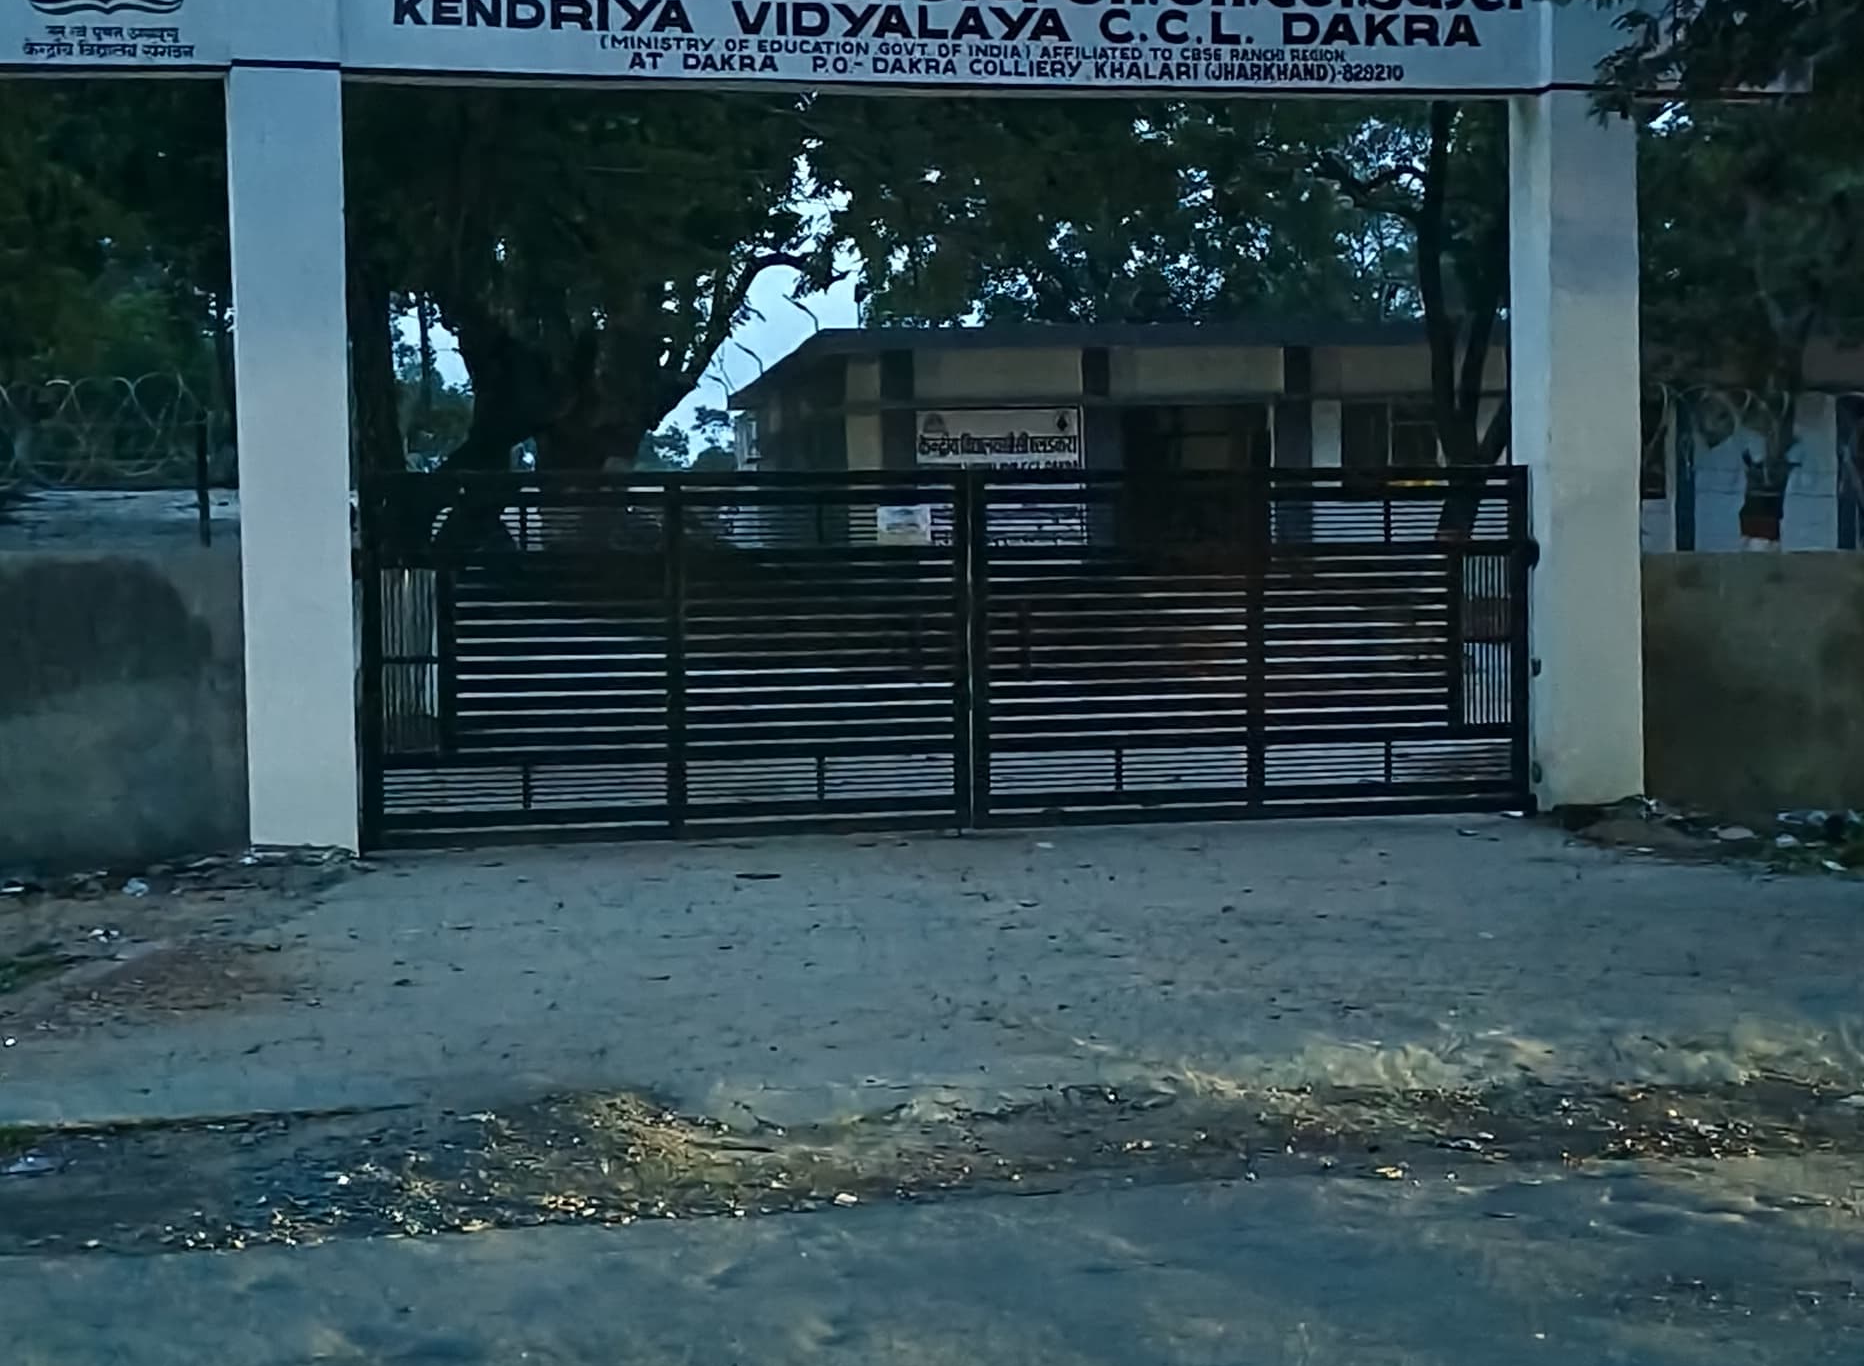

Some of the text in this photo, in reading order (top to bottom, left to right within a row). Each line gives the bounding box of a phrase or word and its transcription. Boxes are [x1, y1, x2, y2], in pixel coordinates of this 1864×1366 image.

[732, 0, 1072, 42] VIDYALAYA
[1282, 12, 1481, 47] DAKRA
[600, 34, 714, 52] (MINISTRY
[725, 38, 751, 52] OF
[757, 39, 869, 56] EDUCATION
[938, 43, 962, 57] OF
[968, 44, 1031, 60] INDIA)
[1040, 46, 1143, 61] AFFILIATED
[1149, 47, 1173, 62] TO
[1180, 48, 1222, 62] CBSE
[1230, 48, 1285, 62] RANCHI
[1290, 49, 1346, 63] REGION
[629, 52, 664, 70] AT
[683, 54, 779, 72] DAKRA
[873, 57, 957, 75] DAKRA
[1095, 61, 1198, 81] KHALARI
